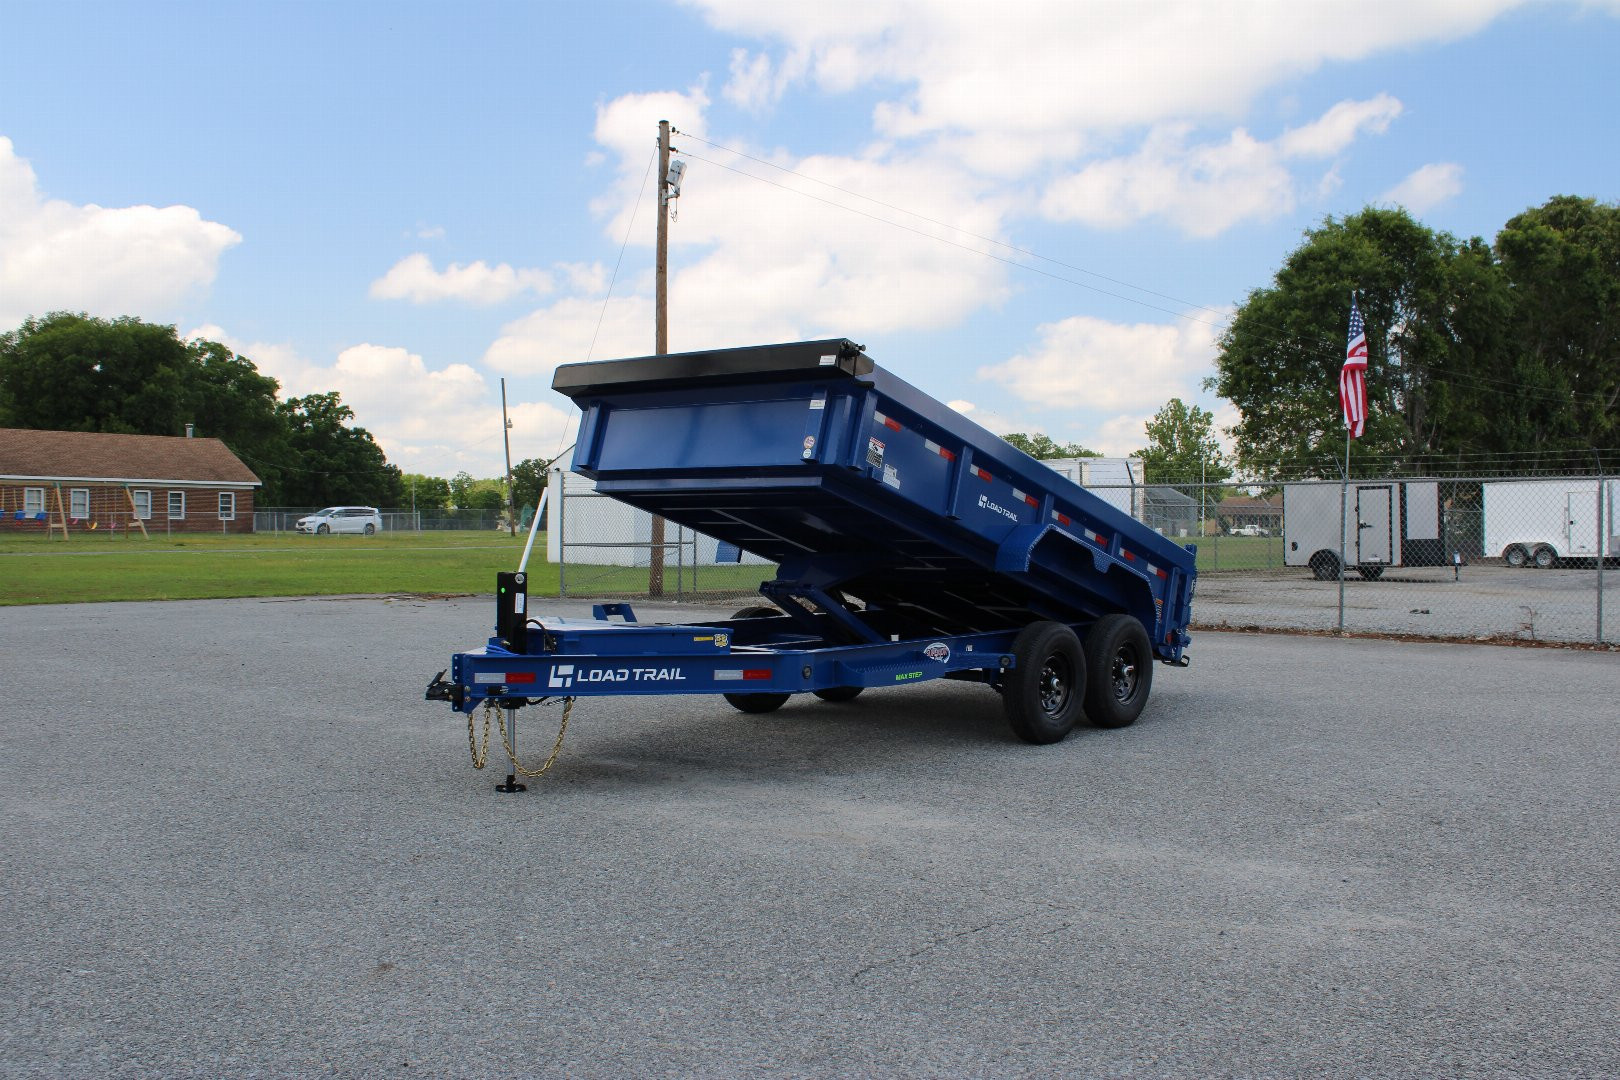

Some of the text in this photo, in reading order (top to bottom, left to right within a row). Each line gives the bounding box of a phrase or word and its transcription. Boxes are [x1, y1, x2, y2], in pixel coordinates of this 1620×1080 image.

[987, 501, 1003, 513] LOAD
[577, 668, 686, 682] LOAD TRAIL
[908, 671, 922, 679] STEP
